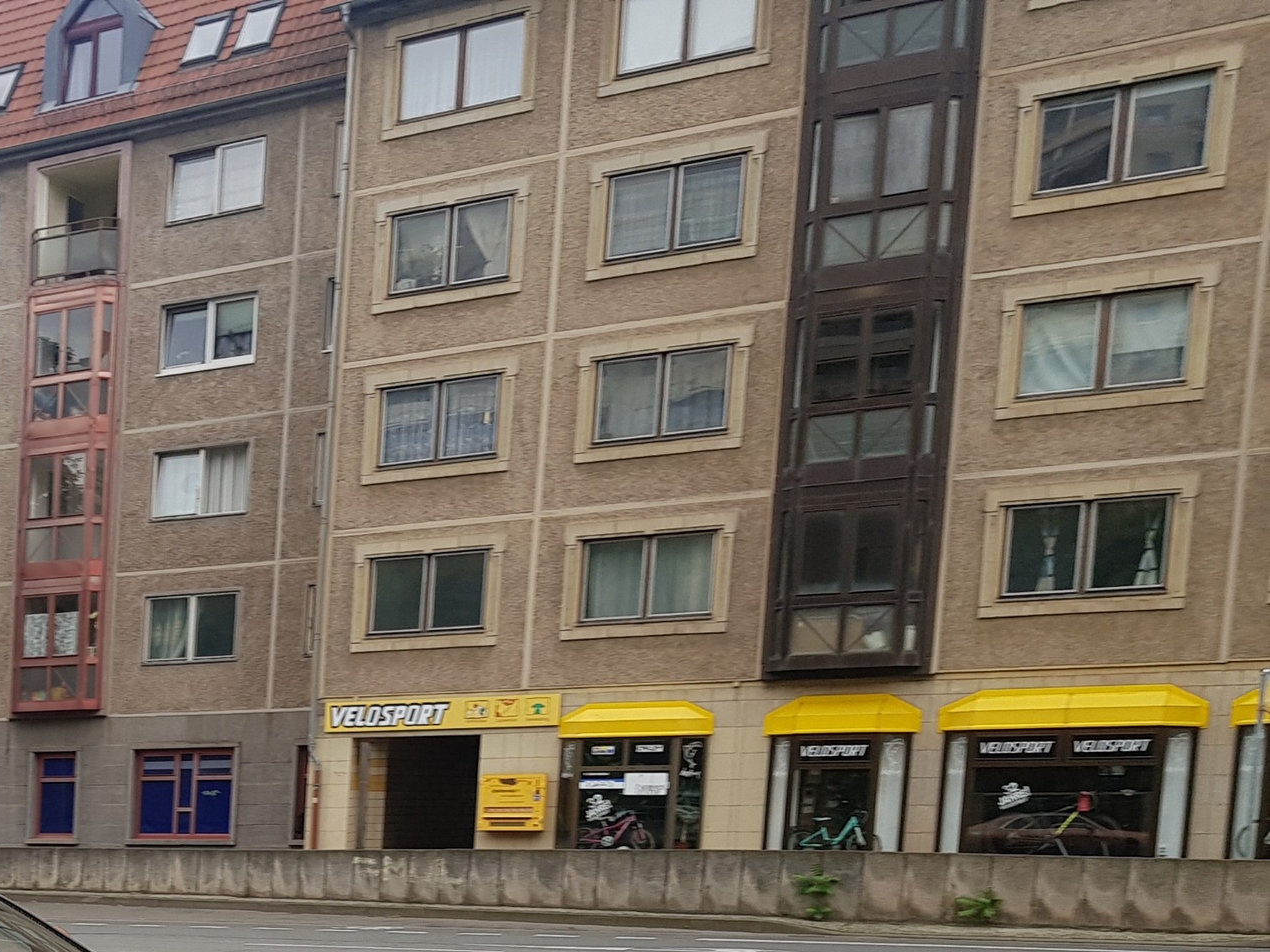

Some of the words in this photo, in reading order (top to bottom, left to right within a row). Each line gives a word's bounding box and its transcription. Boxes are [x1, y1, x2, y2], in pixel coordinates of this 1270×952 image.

[330, 702, 450, 728] VELOSPORT
[800, 744, 870, 757] VELOSPORT
[979, 740, 1056, 754] VELOSPORT
[1073, 738, 1153, 753] VELOSPORT
